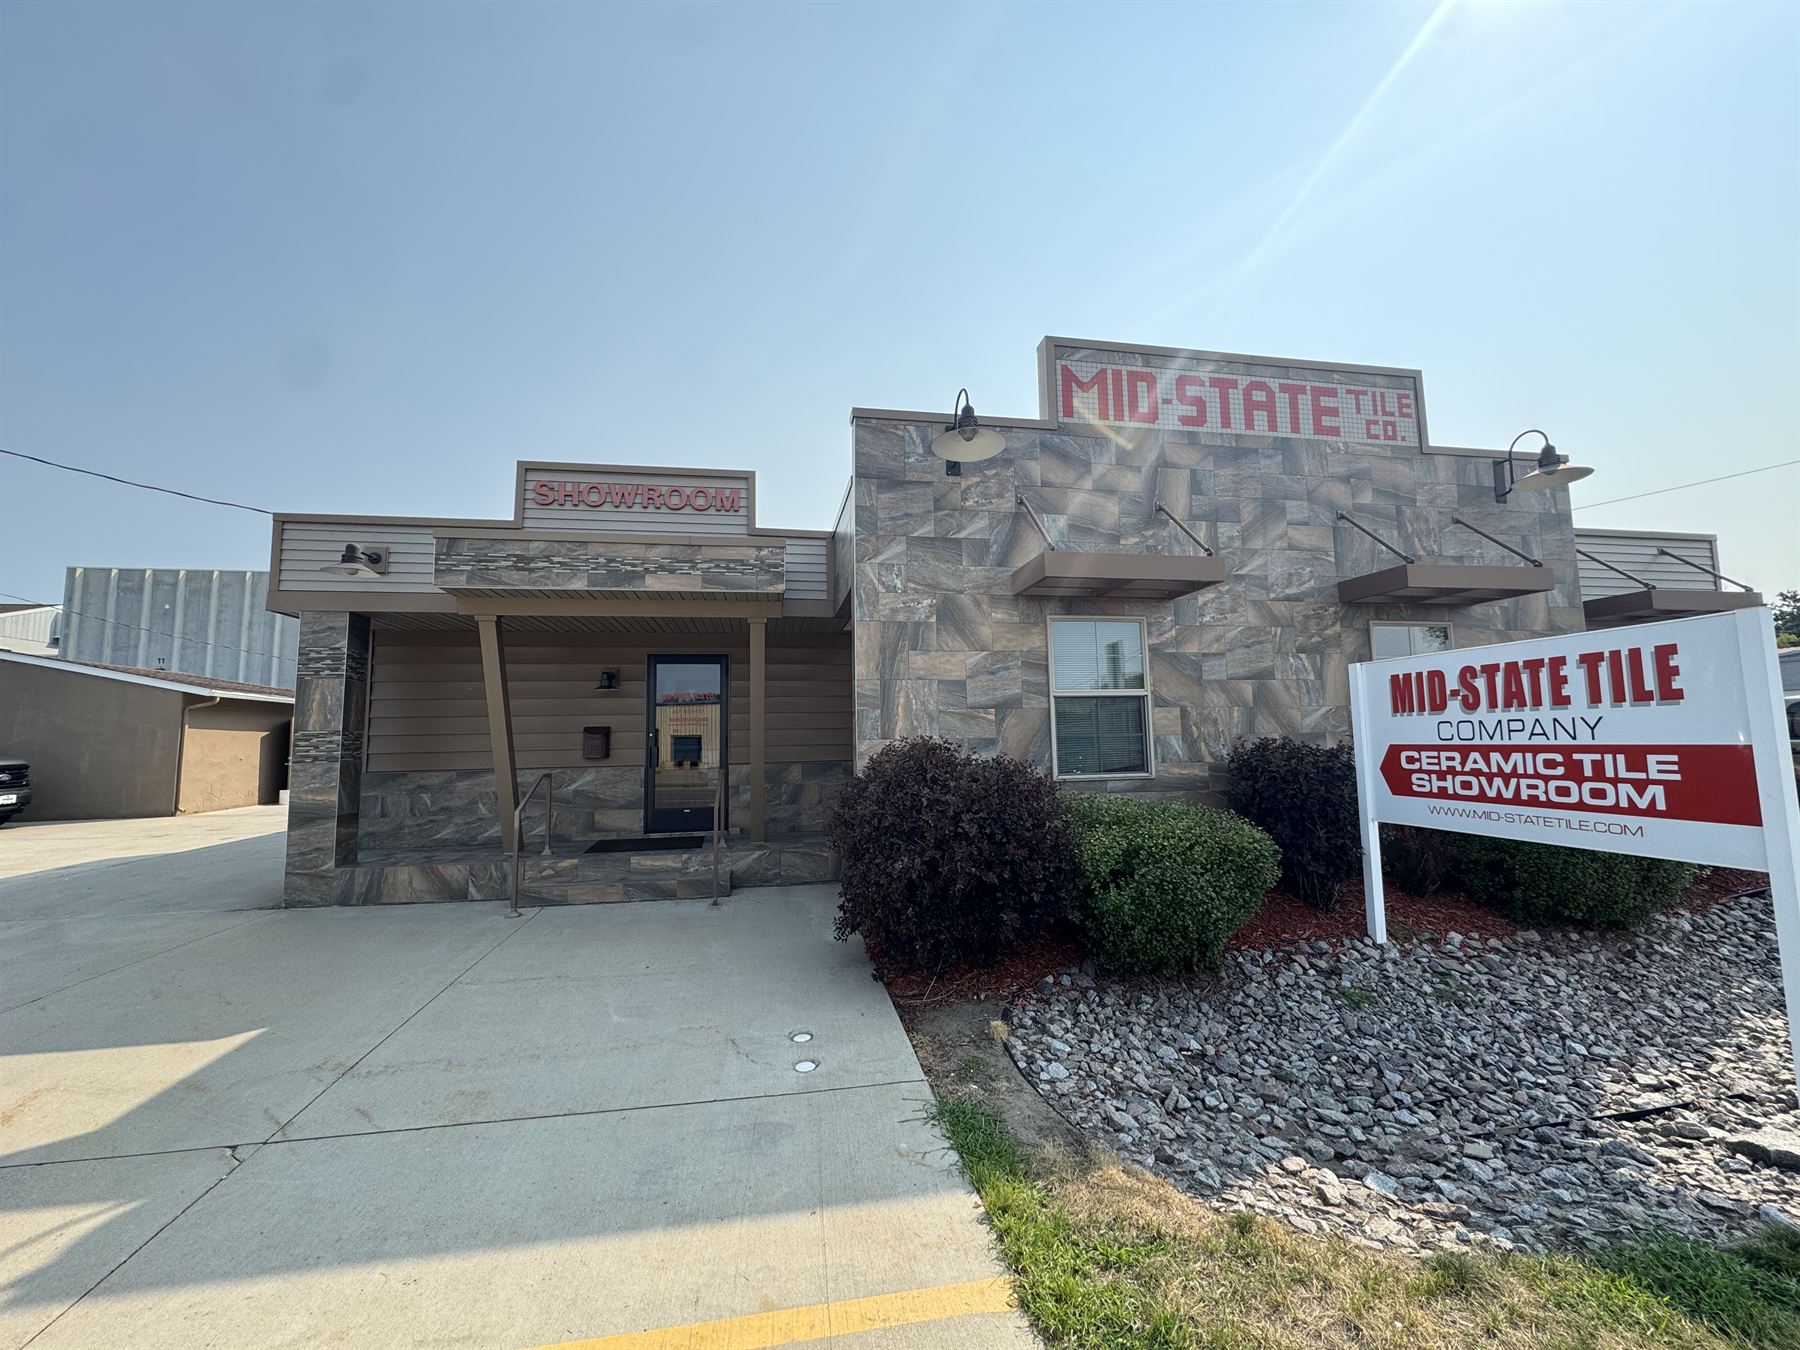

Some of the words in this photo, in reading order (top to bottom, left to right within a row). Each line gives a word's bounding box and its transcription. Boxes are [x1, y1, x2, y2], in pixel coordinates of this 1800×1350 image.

[1060, 364, 1341, 437] MID-STATE
[1345, 388, 1413, 419] TILE
[1365, 419, 1407, 442] CO.
[532, 480, 741, 513] SHOWROOM
[1389, 655, 1572, 716] MID-STATE
[1577, 643, 1685, 708] TILE
[1436, 716, 1604, 741] COMPANY
[1400, 750, 1566, 776] CERAMIC
[1571, 753, 1682, 781] TILE
[1411, 773, 1667, 811] SHOWROOM
[1427, 804, 1644, 838] WWW.MID-STATETILE.COM
